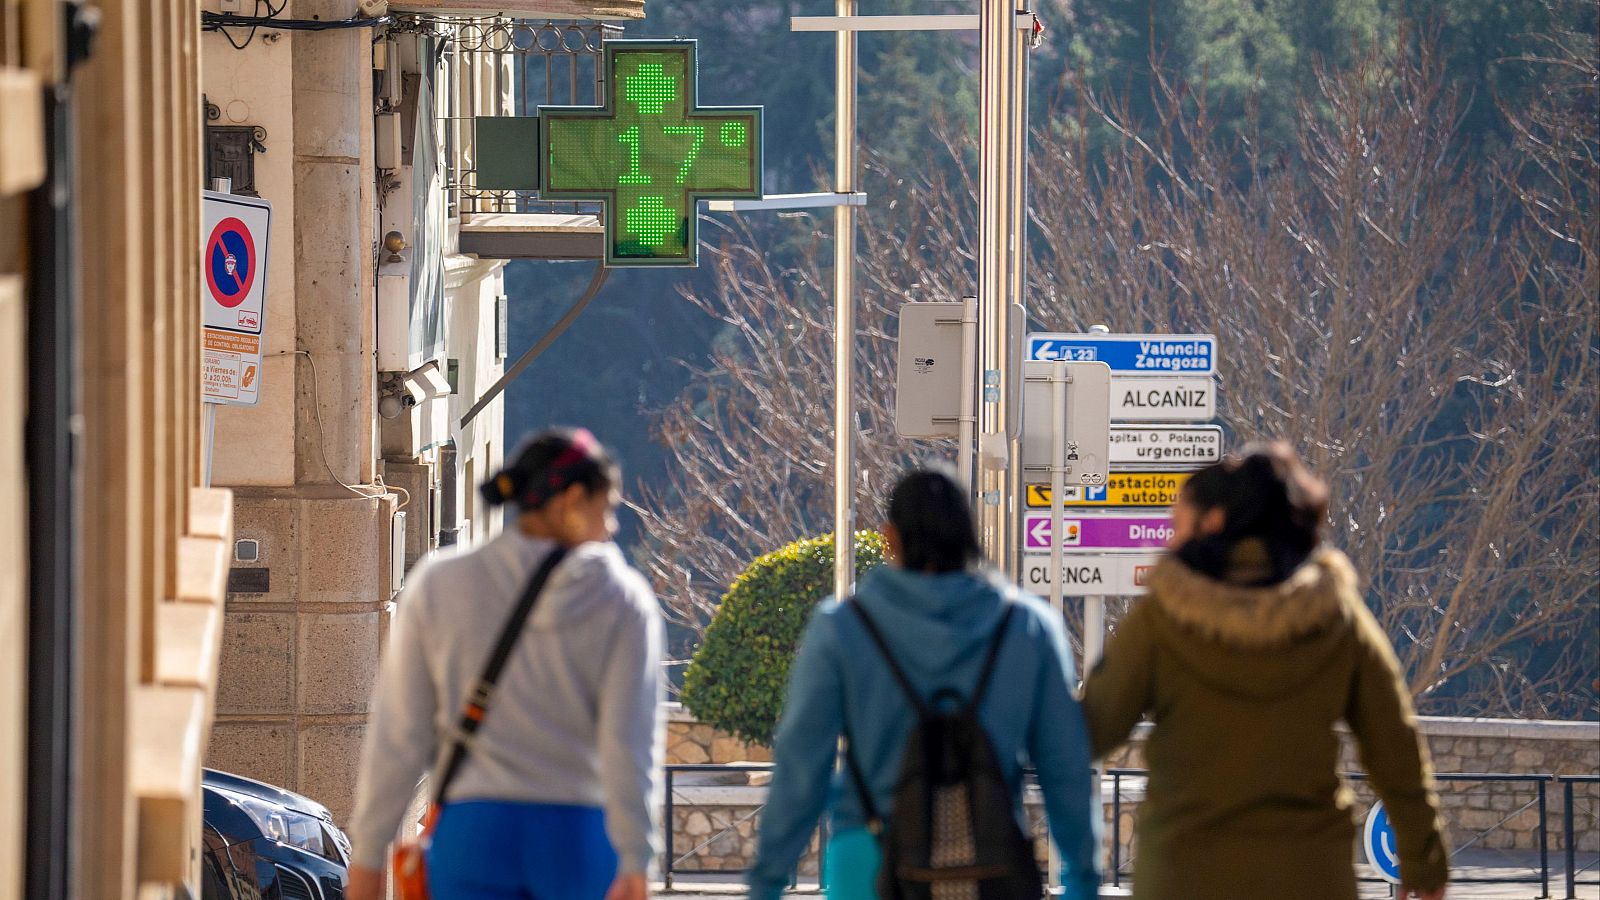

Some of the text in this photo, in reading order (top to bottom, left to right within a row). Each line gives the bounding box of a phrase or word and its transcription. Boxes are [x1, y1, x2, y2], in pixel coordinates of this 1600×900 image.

[1140, 341, 1208, 355] Valencia
[1135, 354, 1208, 370] Zaragoza
[1122, 386, 1206, 407] ALCAÑIZ
[1110, 433, 1142, 443] spital
[1169, 433, 1215, 443] Polanco
[1137, 444, 1215, 459] urgencias
[1109, 475, 1176, 488] estación
[1122, 491, 1177, 503] autobu
[1129, 524, 1175, 541] Dinóp
[1030, 567, 1103, 584] CUNCA
